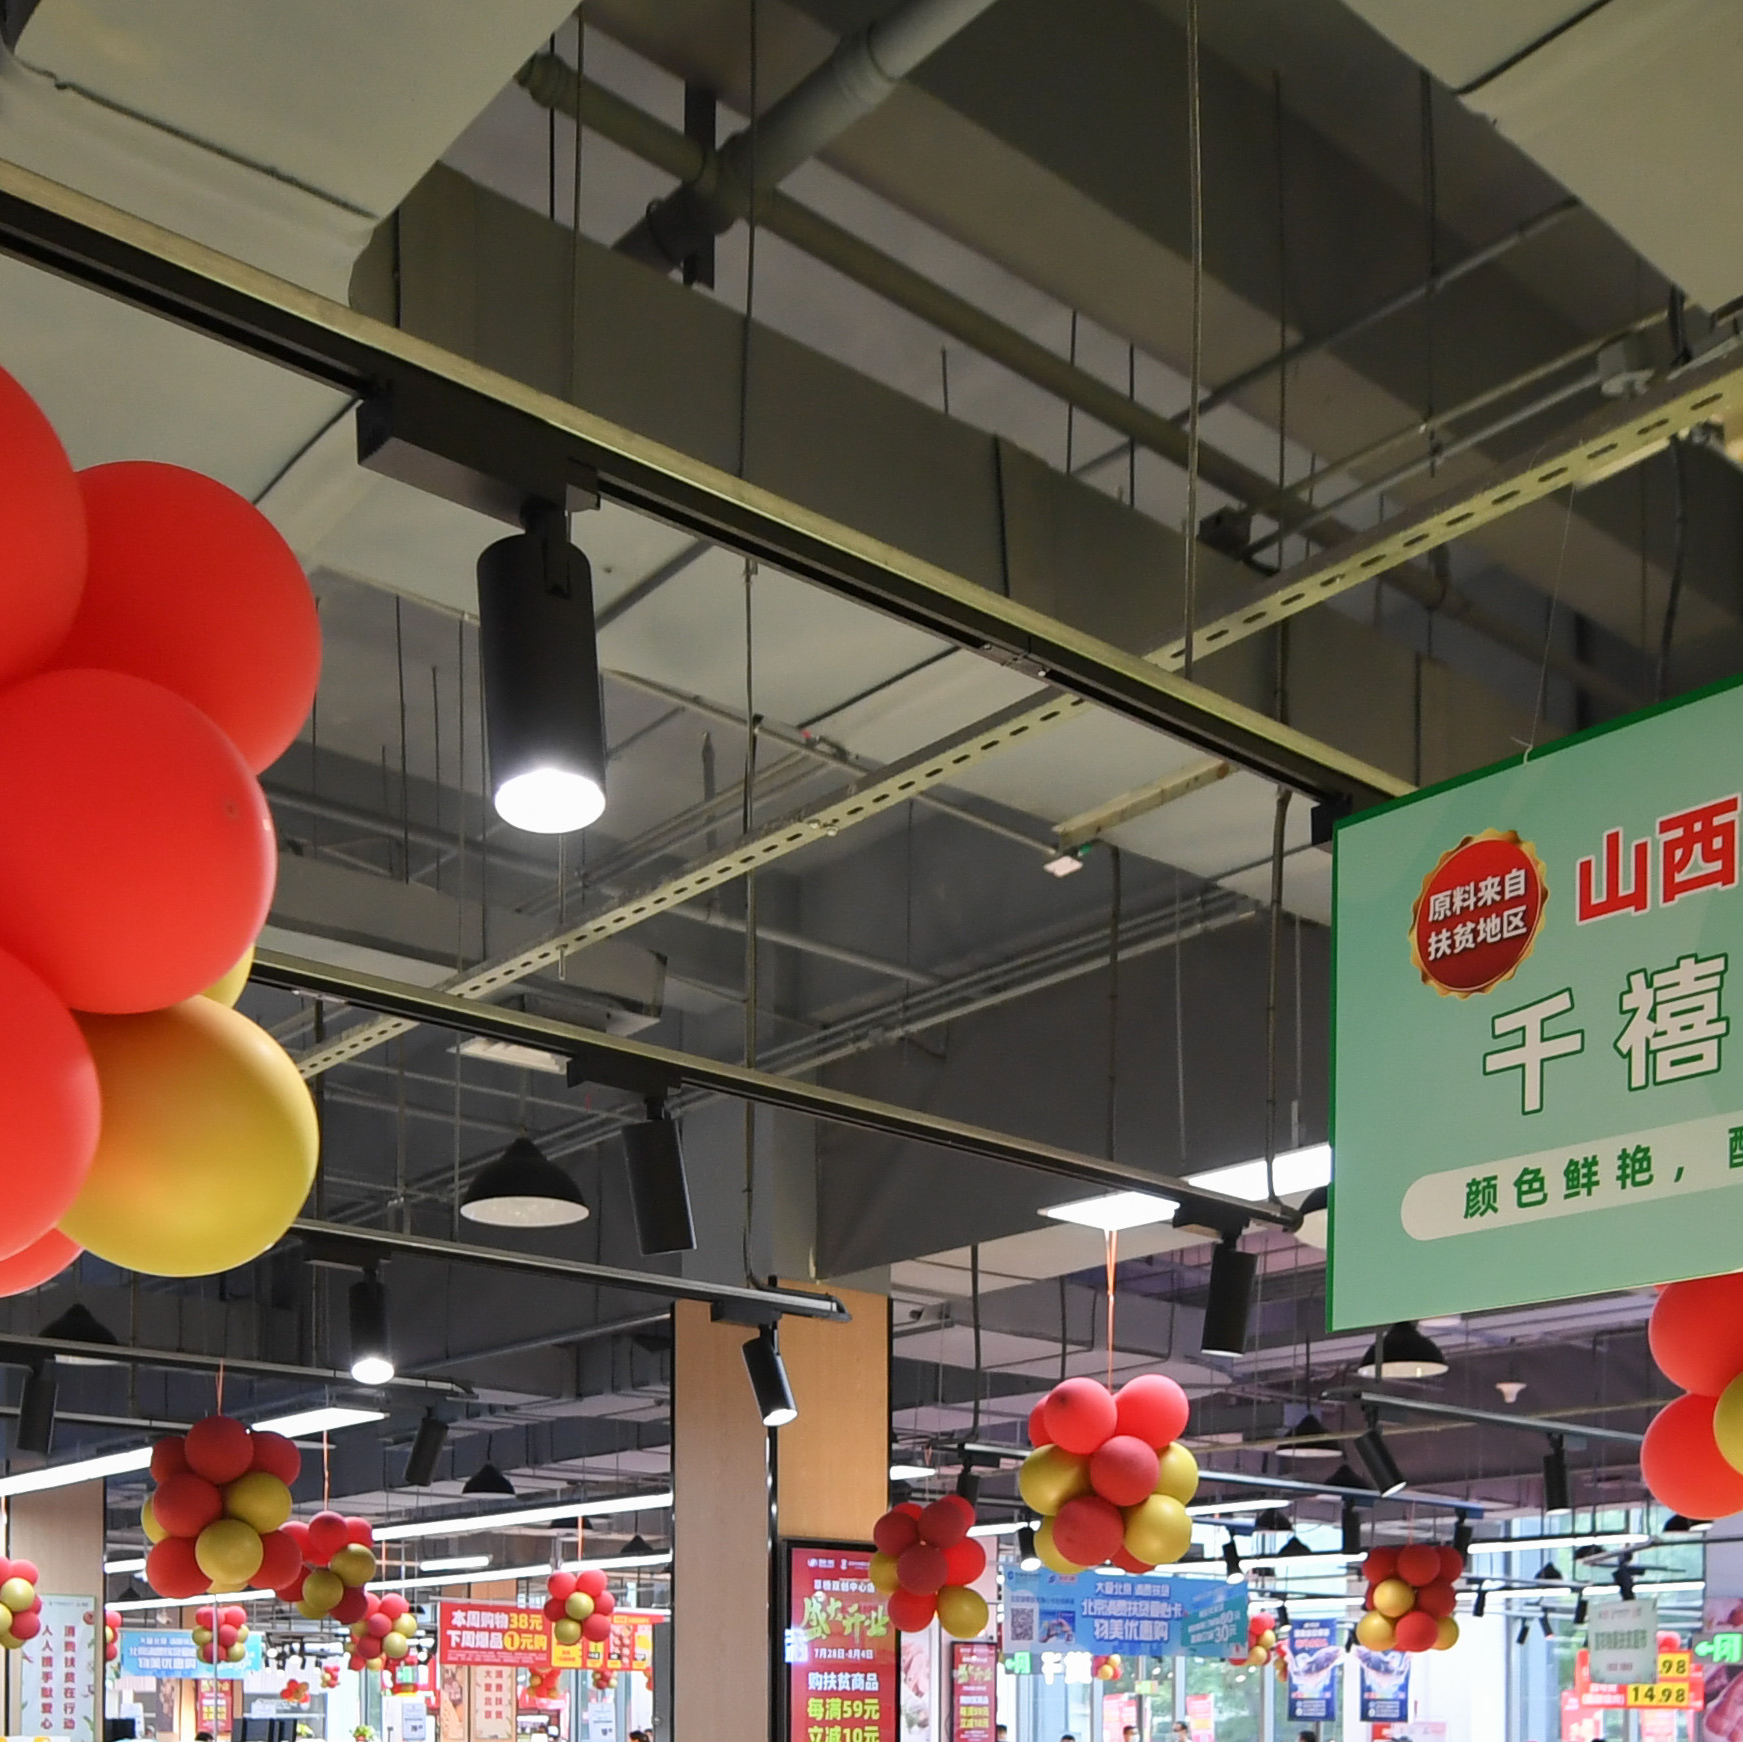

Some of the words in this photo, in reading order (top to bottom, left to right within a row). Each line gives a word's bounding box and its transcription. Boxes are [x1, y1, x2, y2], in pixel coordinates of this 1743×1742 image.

[1426, 866, 1528, 925] 原料来自
[1426, 905, 1528, 962] 扶贫地区
[808, 1671, 880, 1691] 购扶贫商品
[807, 1698, 880, 1720] 每满59元
